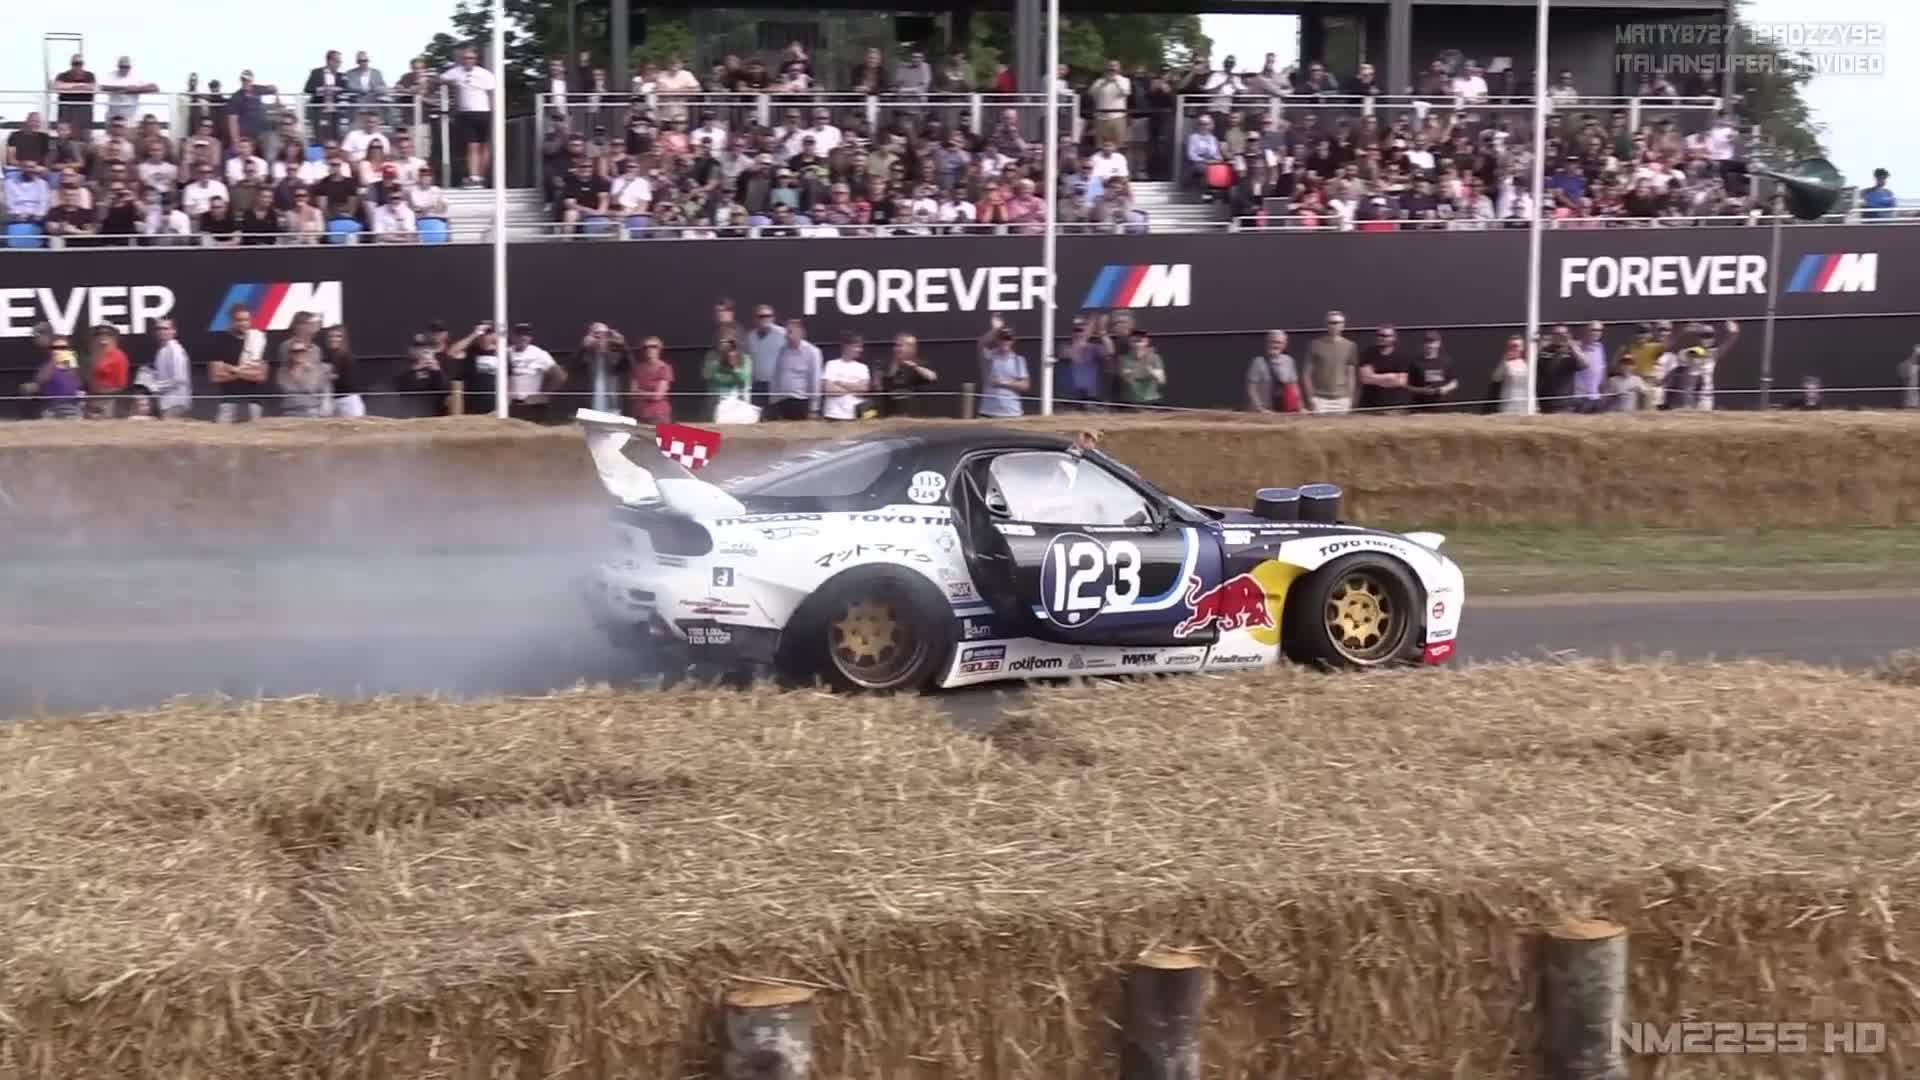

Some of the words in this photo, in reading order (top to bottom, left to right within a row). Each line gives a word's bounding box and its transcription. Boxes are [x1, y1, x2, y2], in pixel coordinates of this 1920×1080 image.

[1560, 254, 1768, 298] FOREVER
[803, 265, 1058, 316] FOREVER
[0, 285, 176, 337] EVER
[919, 476, 942, 487] 115
[849, 514, 916, 525] TOYO
[1319, 540, 1361, 557] TOYO
[1053, 540, 1142, 611] 123
[1008, 656, 1063, 671] rotiform
[1211, 654, 1263, 666] Haltech
